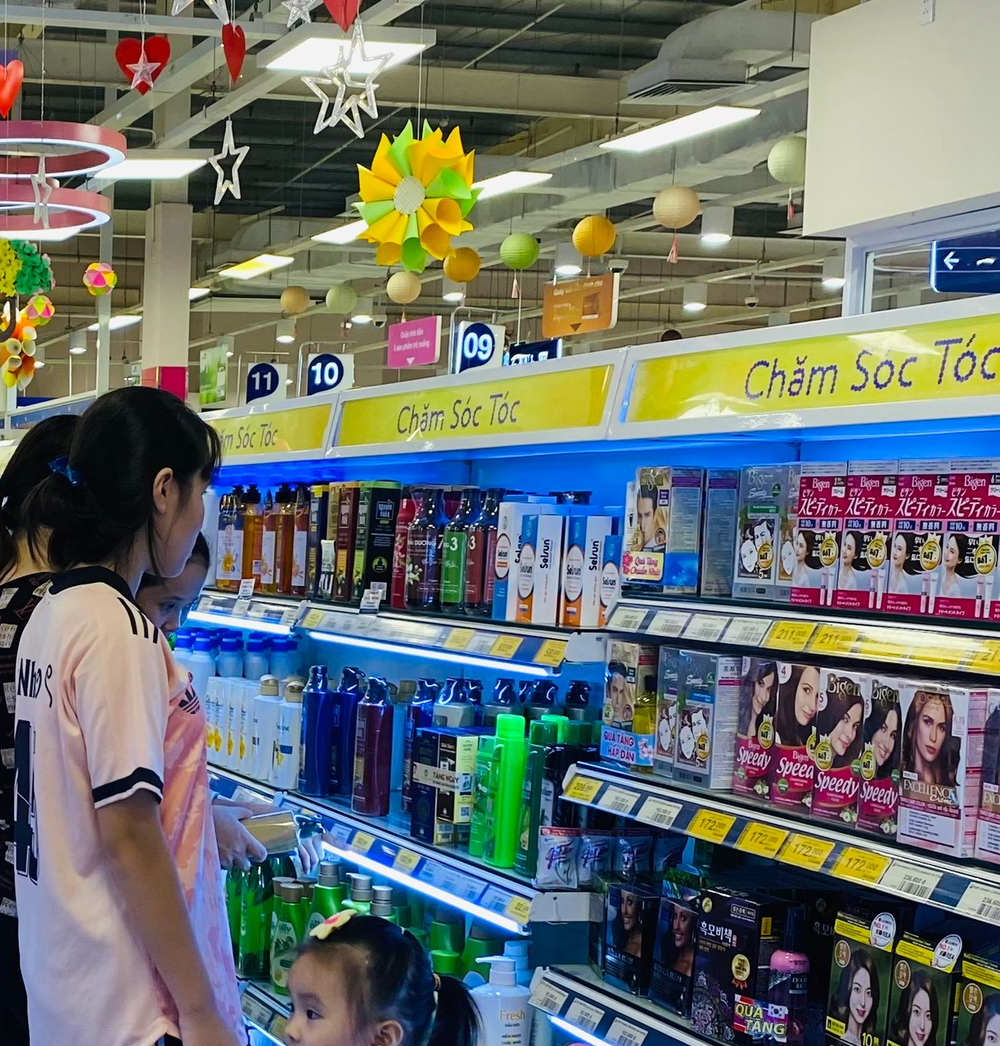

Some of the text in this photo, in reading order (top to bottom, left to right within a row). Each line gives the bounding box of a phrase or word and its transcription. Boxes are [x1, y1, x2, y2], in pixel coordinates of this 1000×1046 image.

[463, 332, 493, 360] 09
[311, 362, 339, 386] 10
[745, 334, 1000, 399] Chăm Sóc Tóc
[251, 372, 272, 391] 11
[398, 393, 520, 433] Chăm Sóc Tóc
[236, 424, 256, 449] Sóc
[258, 422, 279, 448] Tóc
[812, 478, 831, 492] Bigen
[860, 476, 880, 493] Bigen
[911, 475, 933, 493] Bigen
[964, 475, 986, 492] Bigen
[449, 536, 458, 551] 3
[540, 539, 550, 569] Selsun
[588, 541, 599, 571] Selsun
[780, 666, 787, 677] 4
[827, 674, 861, 700] Bigen
[871, 679, 900, 707] Bigen
[736, 745, 771, 770] Speedy
[815, 770, 859, 798] Speedy
[859, 780, 898, 808] Speedy
[500, 1009, 526, 1021] Fresh
